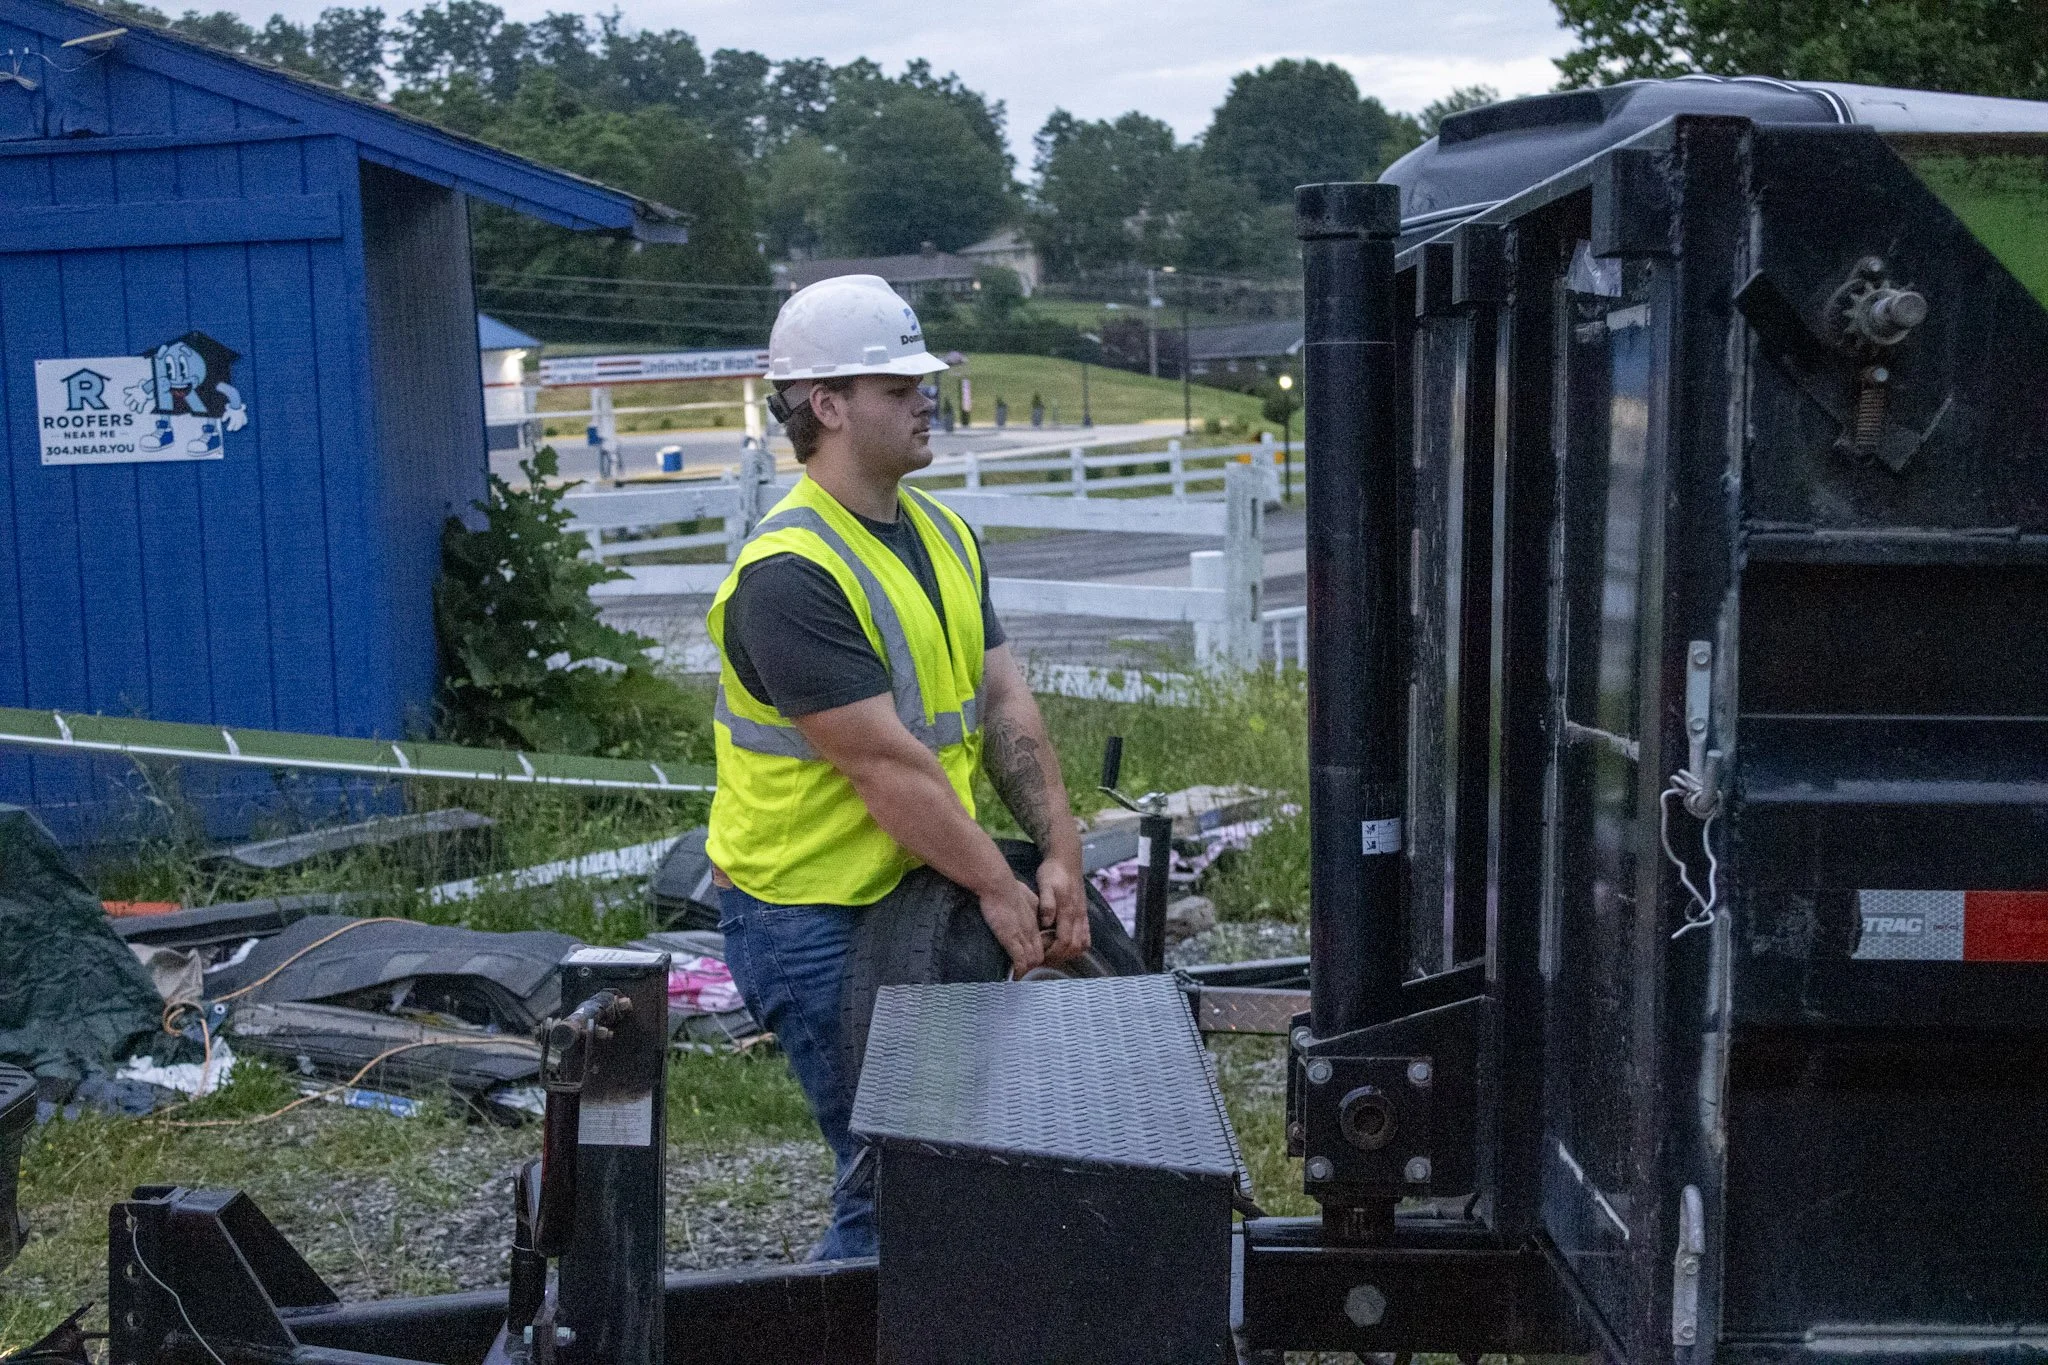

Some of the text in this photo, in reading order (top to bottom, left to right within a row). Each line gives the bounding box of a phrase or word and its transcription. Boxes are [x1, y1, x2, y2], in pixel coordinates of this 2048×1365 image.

[644, 357, 754, 374] Unlimited Car Wash
[43, 414, 134, 429] ROOFERS
[64, 430, 116, 439] NEAR ME
[46, 444, 135, 456] 304.NEAR.YOU
